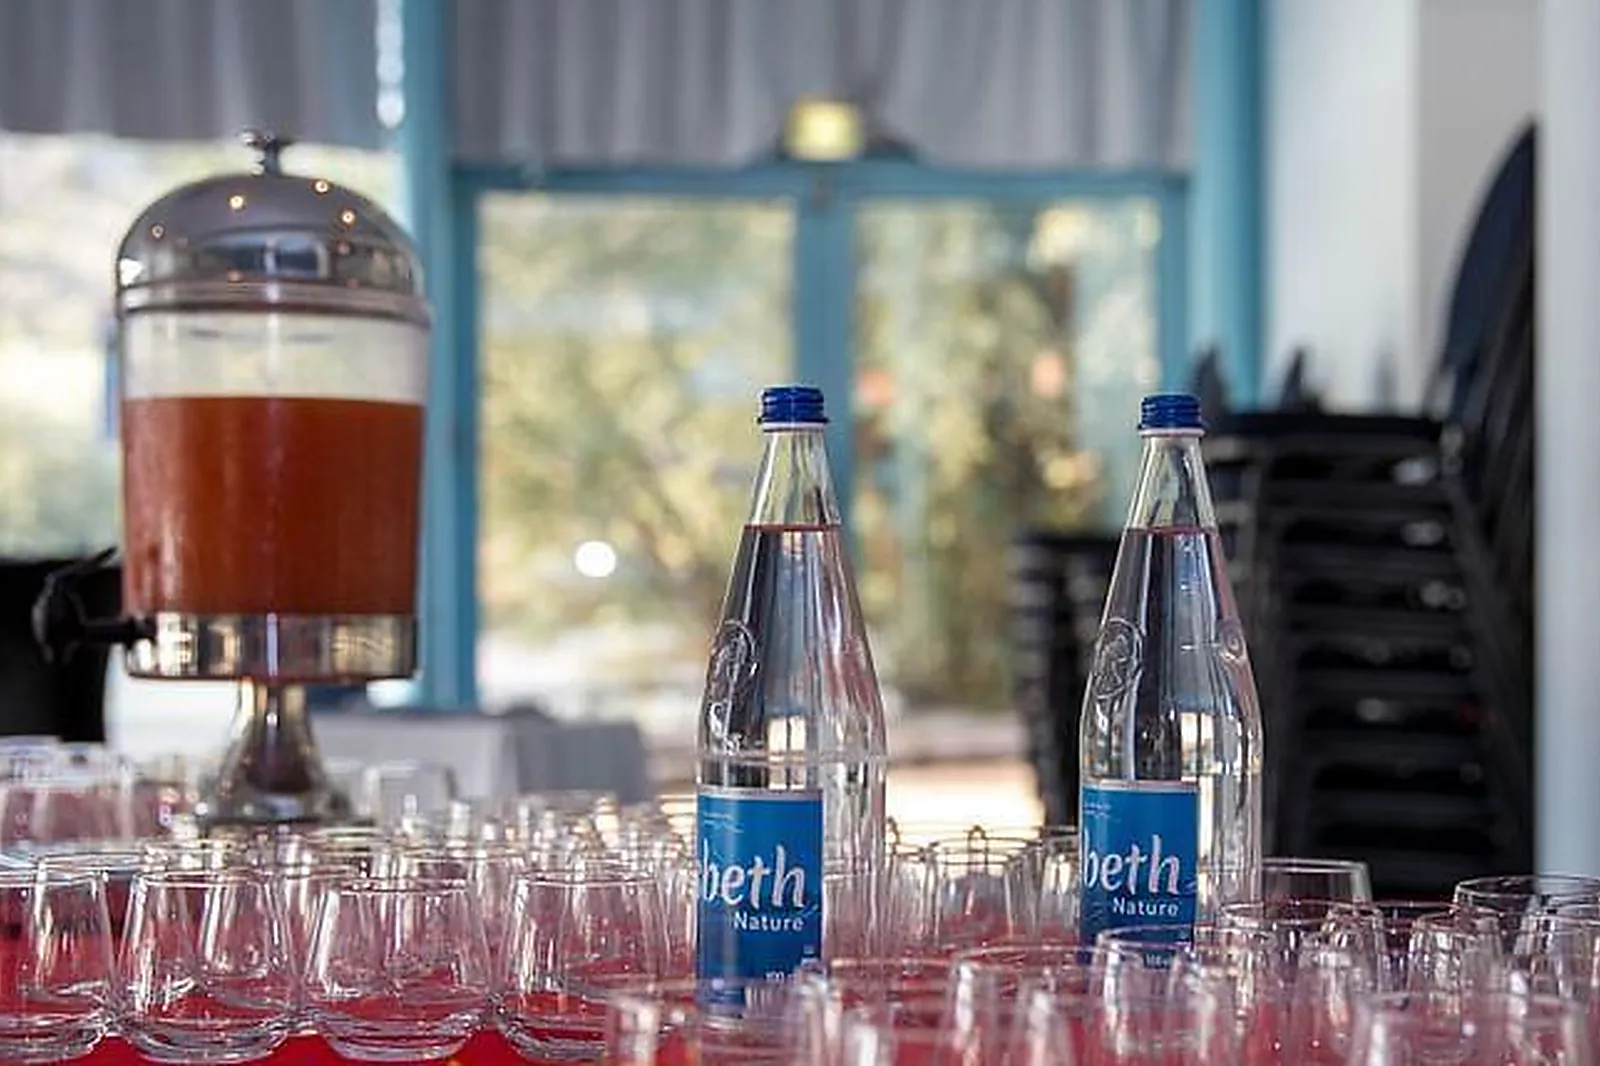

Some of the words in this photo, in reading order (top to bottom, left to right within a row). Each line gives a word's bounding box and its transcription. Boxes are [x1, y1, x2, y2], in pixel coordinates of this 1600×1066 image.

[701, 837, 805, 909] beth
[1083, 827, 1180, 895] beth
[733, 911, 804, 932] Nature
[1113, 897, 1179, 917] Nature
